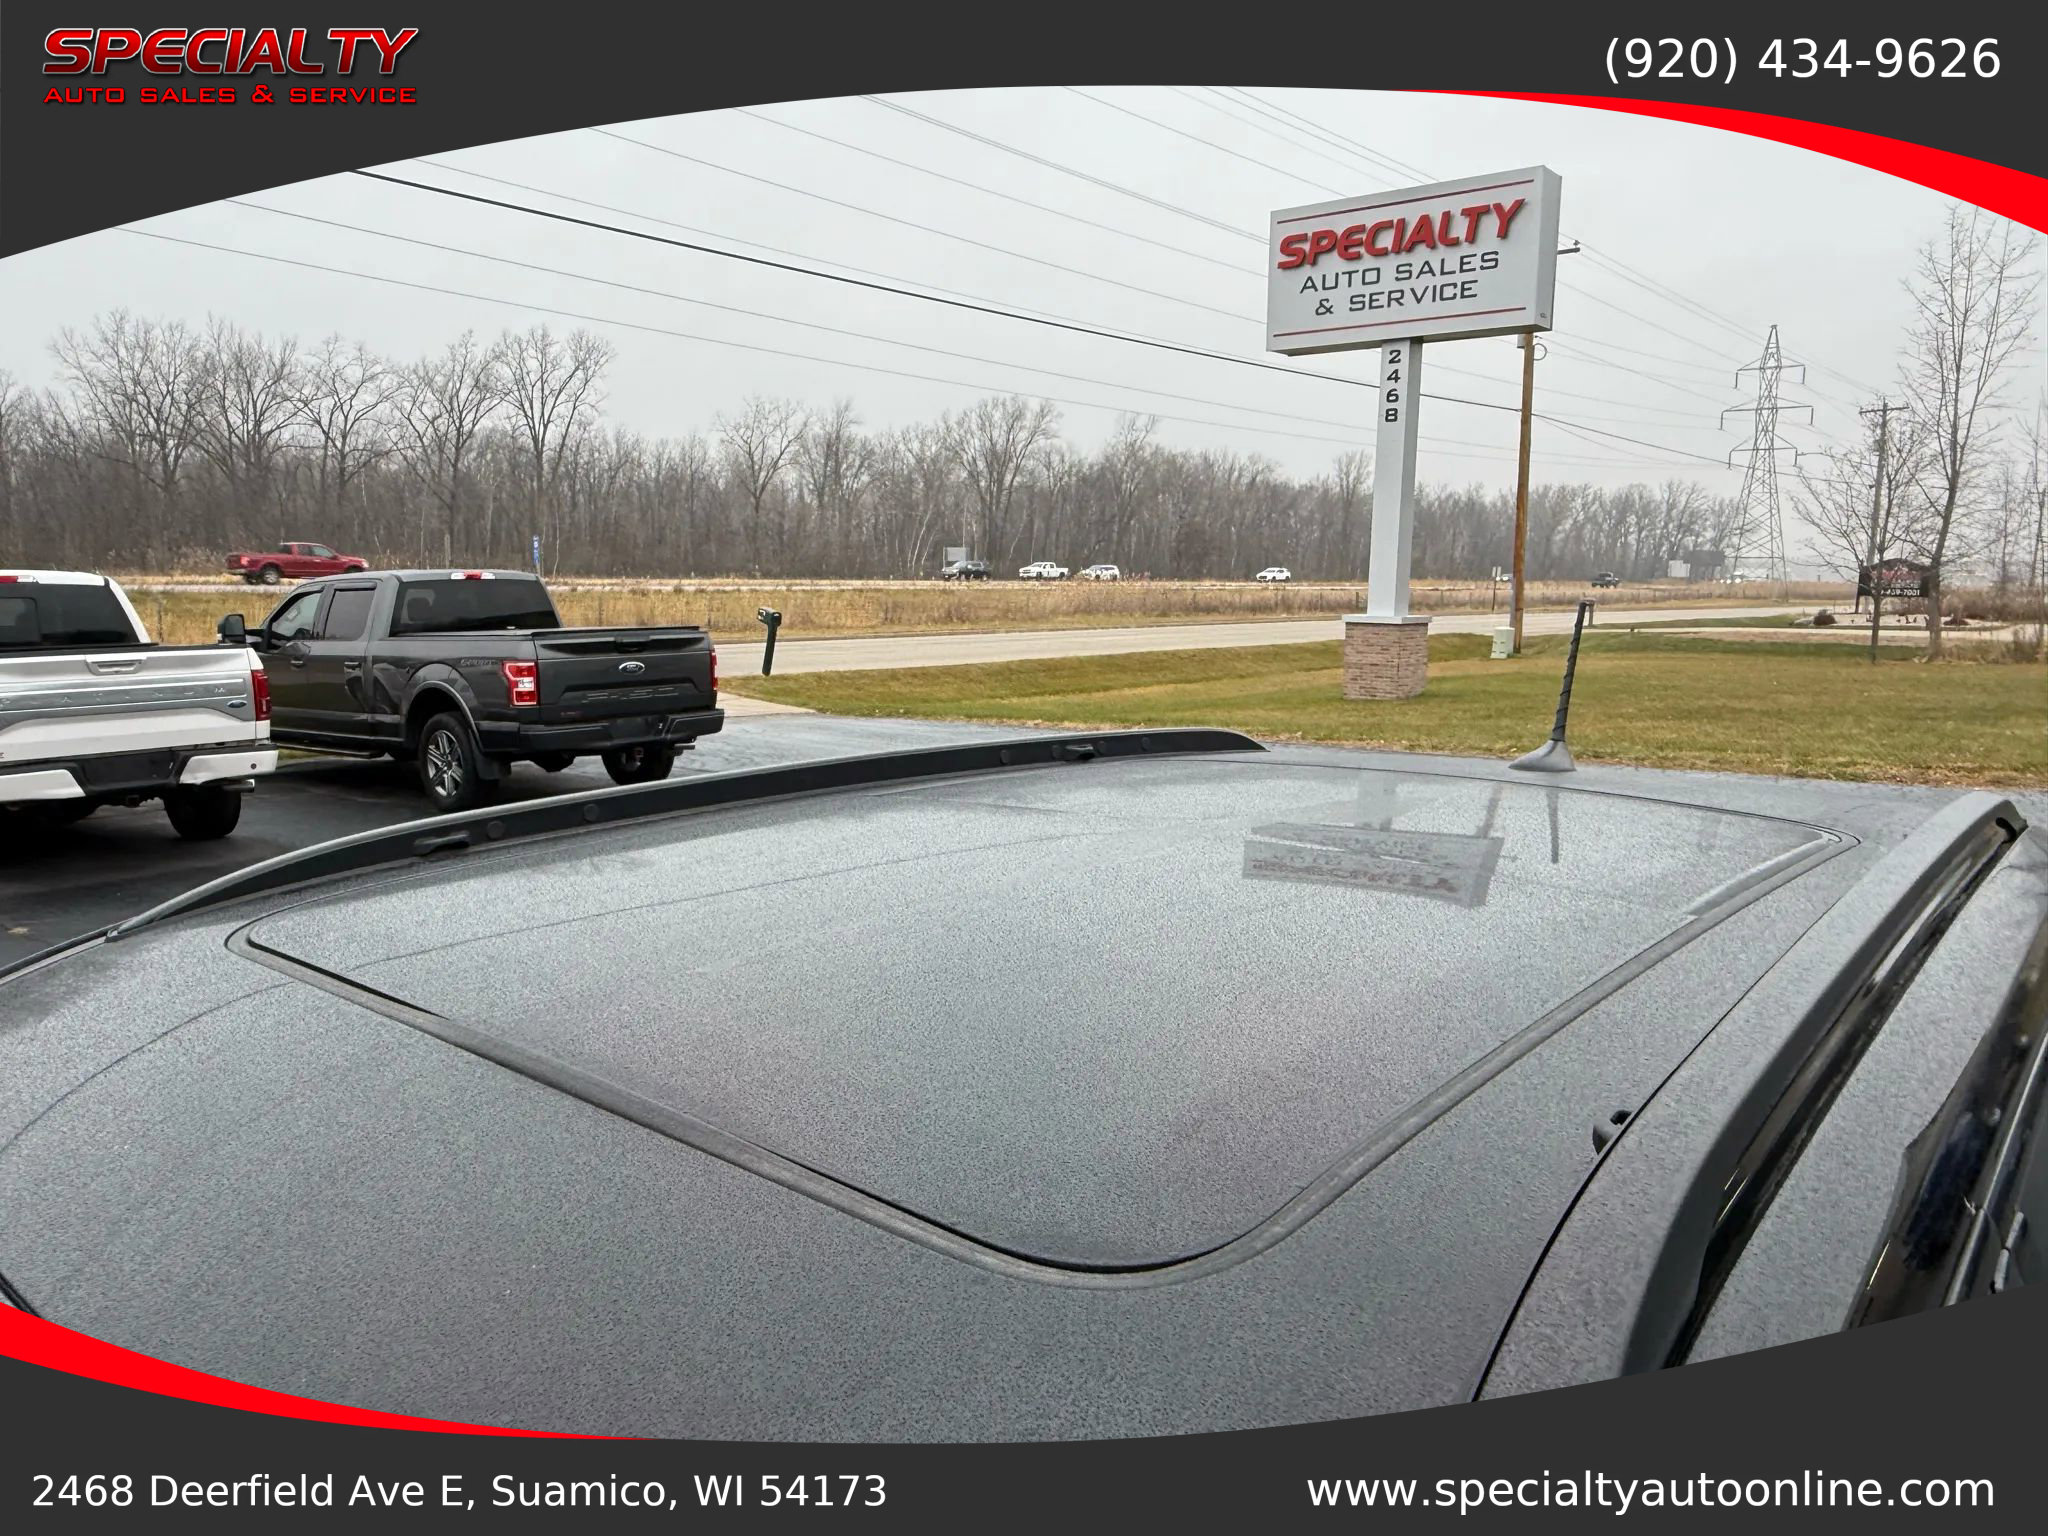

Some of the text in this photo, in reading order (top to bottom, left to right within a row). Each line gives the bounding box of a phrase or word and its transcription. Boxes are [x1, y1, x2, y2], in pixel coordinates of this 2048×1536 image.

[1277, 198, 1526, 270] SPECIALTY
[1300, 250, 1499, 294] AUTO SALES
[1314, 279, 1479, 316] & SERVICE
[1385, 349, 1401, 422] 2468
